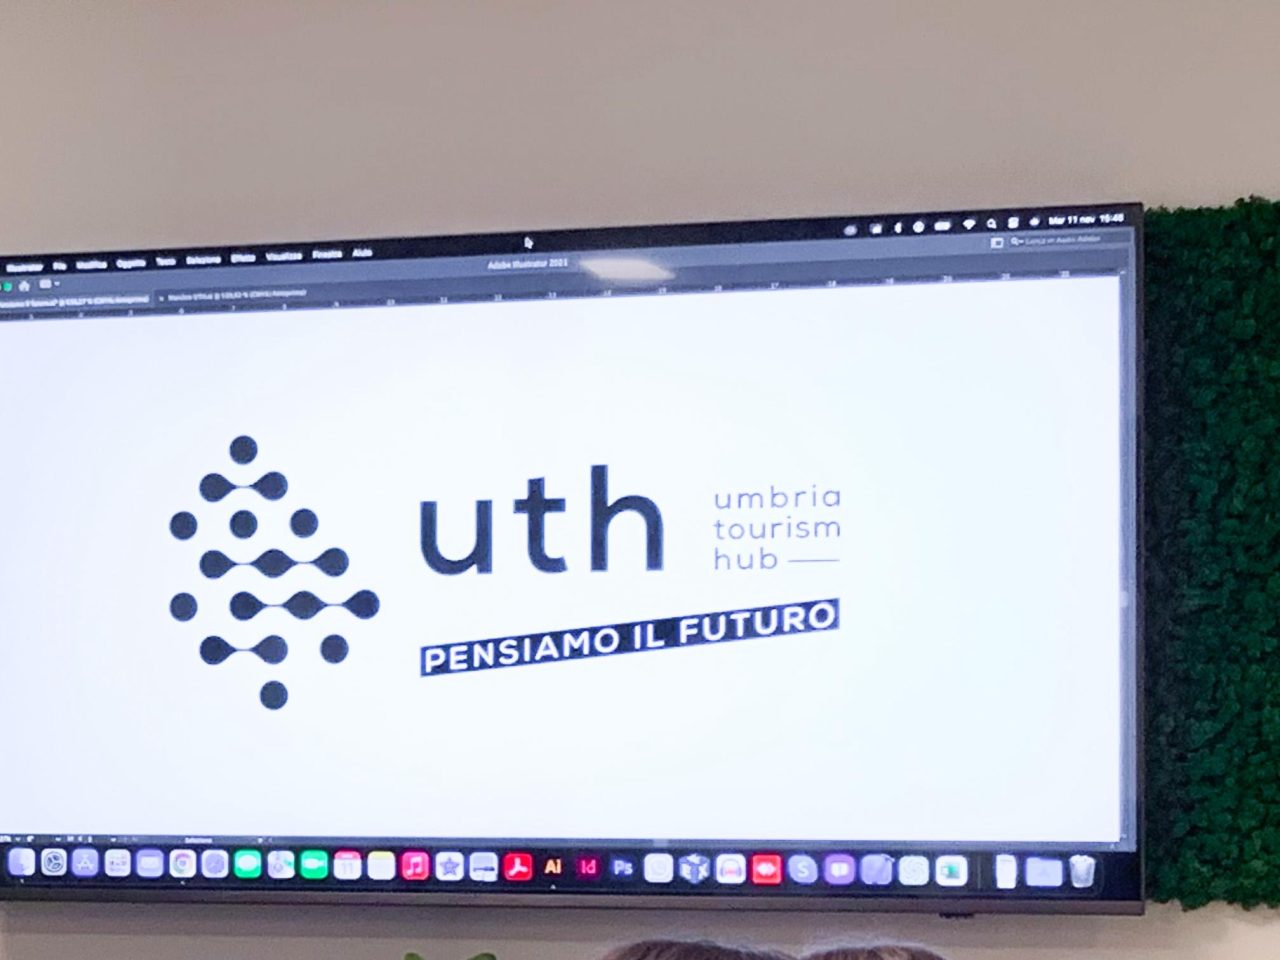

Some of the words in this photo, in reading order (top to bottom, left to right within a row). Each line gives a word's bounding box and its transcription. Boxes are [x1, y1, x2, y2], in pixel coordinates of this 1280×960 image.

[714, 484, 841, 510] umbria
[420, 464, 664, 576] uth
[713, 515, 841, 541] tourism
[714, 546, 779, 571] hub
[424, 626, 620, 675] PENSIAMO
[633, 622, 665, 650] IL
[678, 600, 837, 645] FUTURO
[581, 859, 597, 874] Id
[614, 859, 634, 875] Ps
